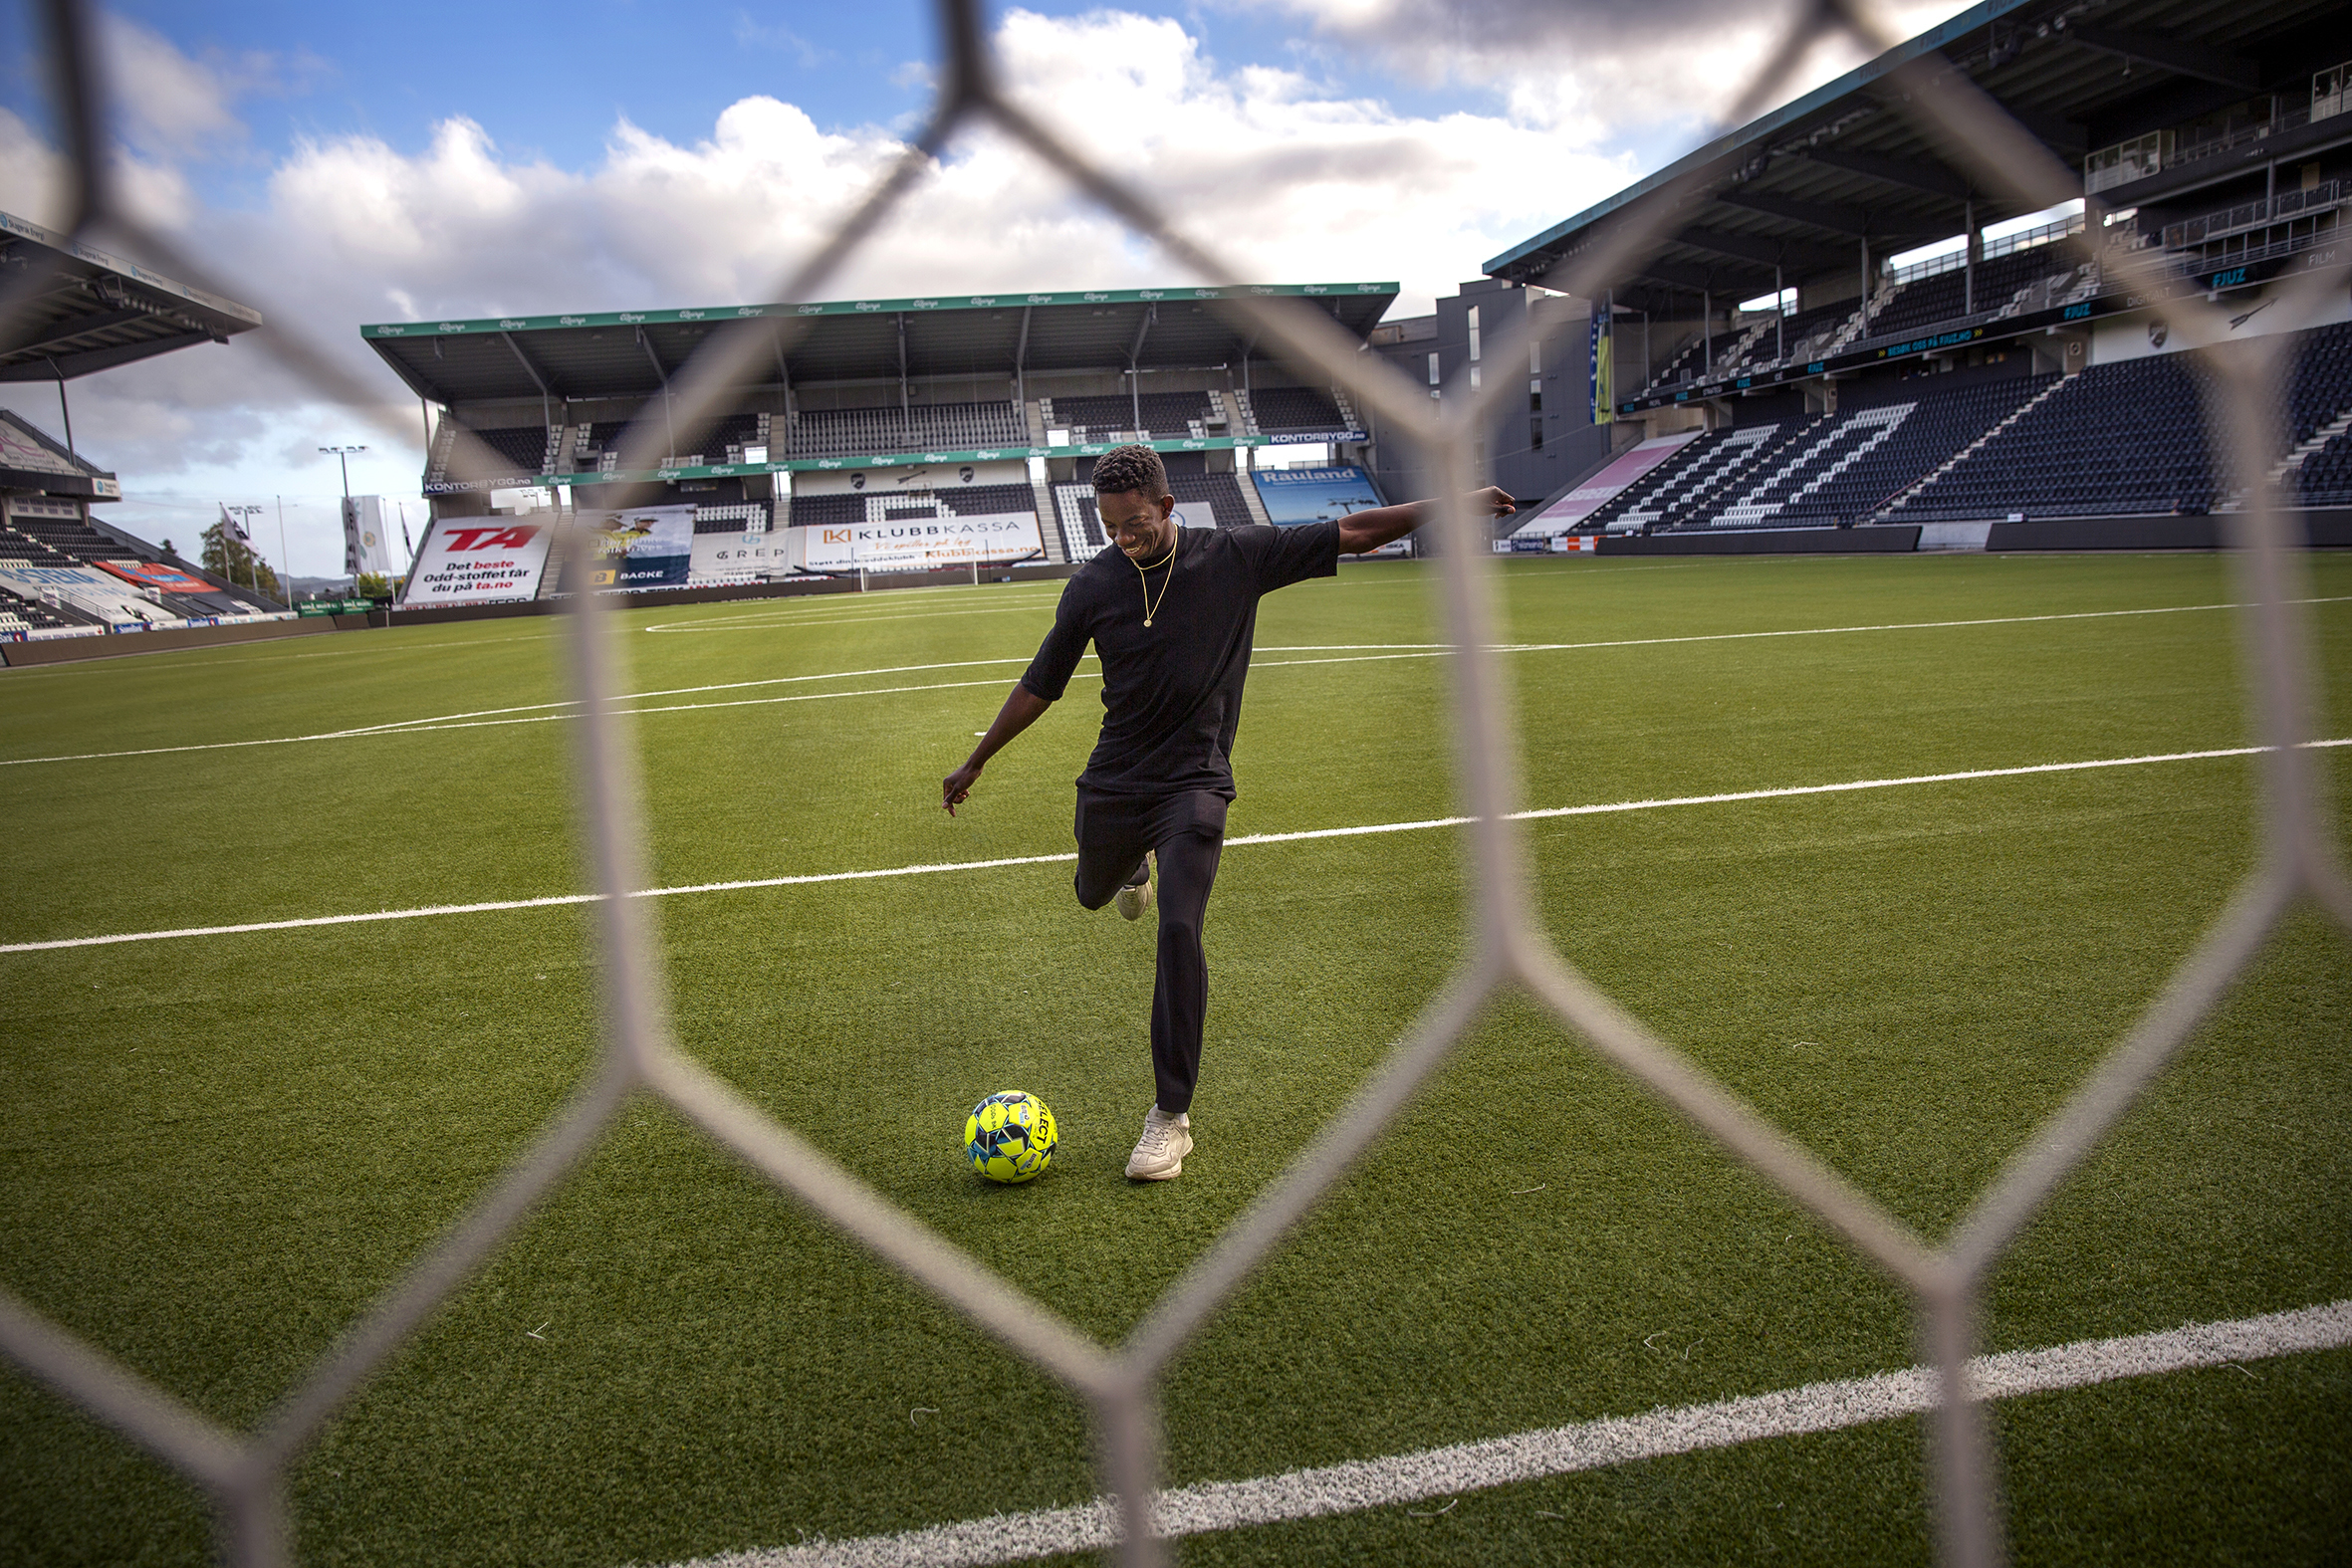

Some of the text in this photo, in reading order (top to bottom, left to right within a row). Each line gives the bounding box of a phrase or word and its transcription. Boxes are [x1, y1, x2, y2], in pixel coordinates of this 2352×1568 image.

[2307, 250, 2336, 266] FILM
[2212, 268, 2246, 288] FJUZ
[2063, 303, 2091, 320] FJUZ
[1271, 431, 1365, 444] KONTORBYGG.no
[1261, 468, 1357, 483] Rauland
[424, 477, 532, 492] KONTORBYGG.no
[859, 521, 1020, 540] KLUBBKASSA
[443, 525, 544, 553] TA
[716, 549, 785, 560] GREP
[446, 560, 515, 571] Det beste
[423, 568, 530, 582] Odd-stoffet får
[620, 570, 664, 579] BACKE
[432, 580, 513, 593] du på ta.no
[1035, 1098, 1050, 1144] SELECT
